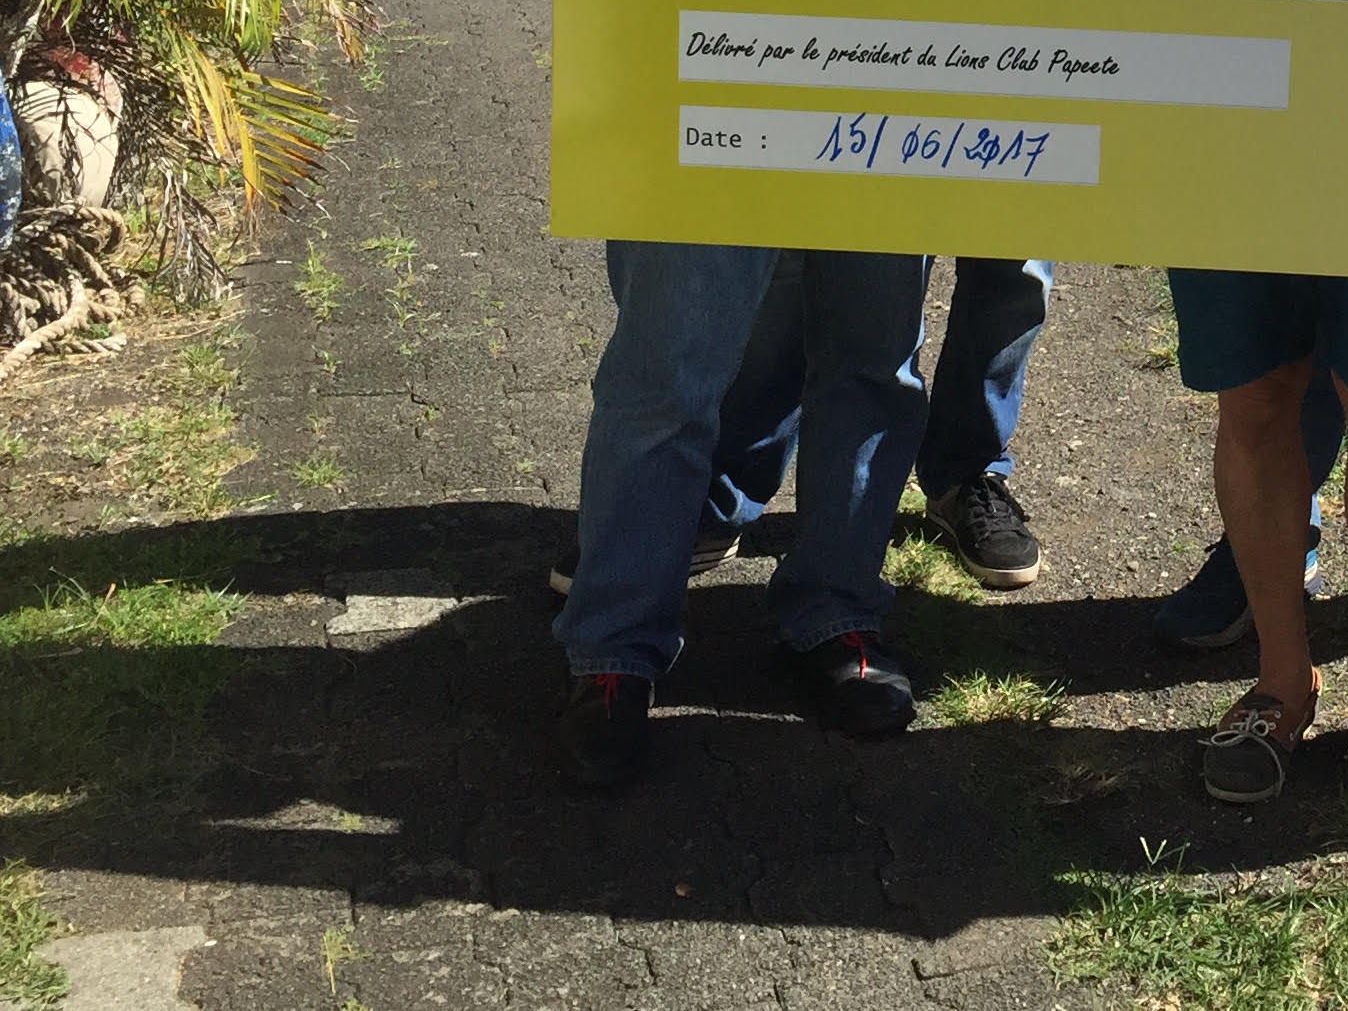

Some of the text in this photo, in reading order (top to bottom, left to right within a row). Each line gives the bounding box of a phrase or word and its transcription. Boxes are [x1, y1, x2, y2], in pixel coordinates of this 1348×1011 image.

[686, 31, 1120, 83] Délivré par le président du Lions Club Papeete
[686, 127, 742, 148] Date
